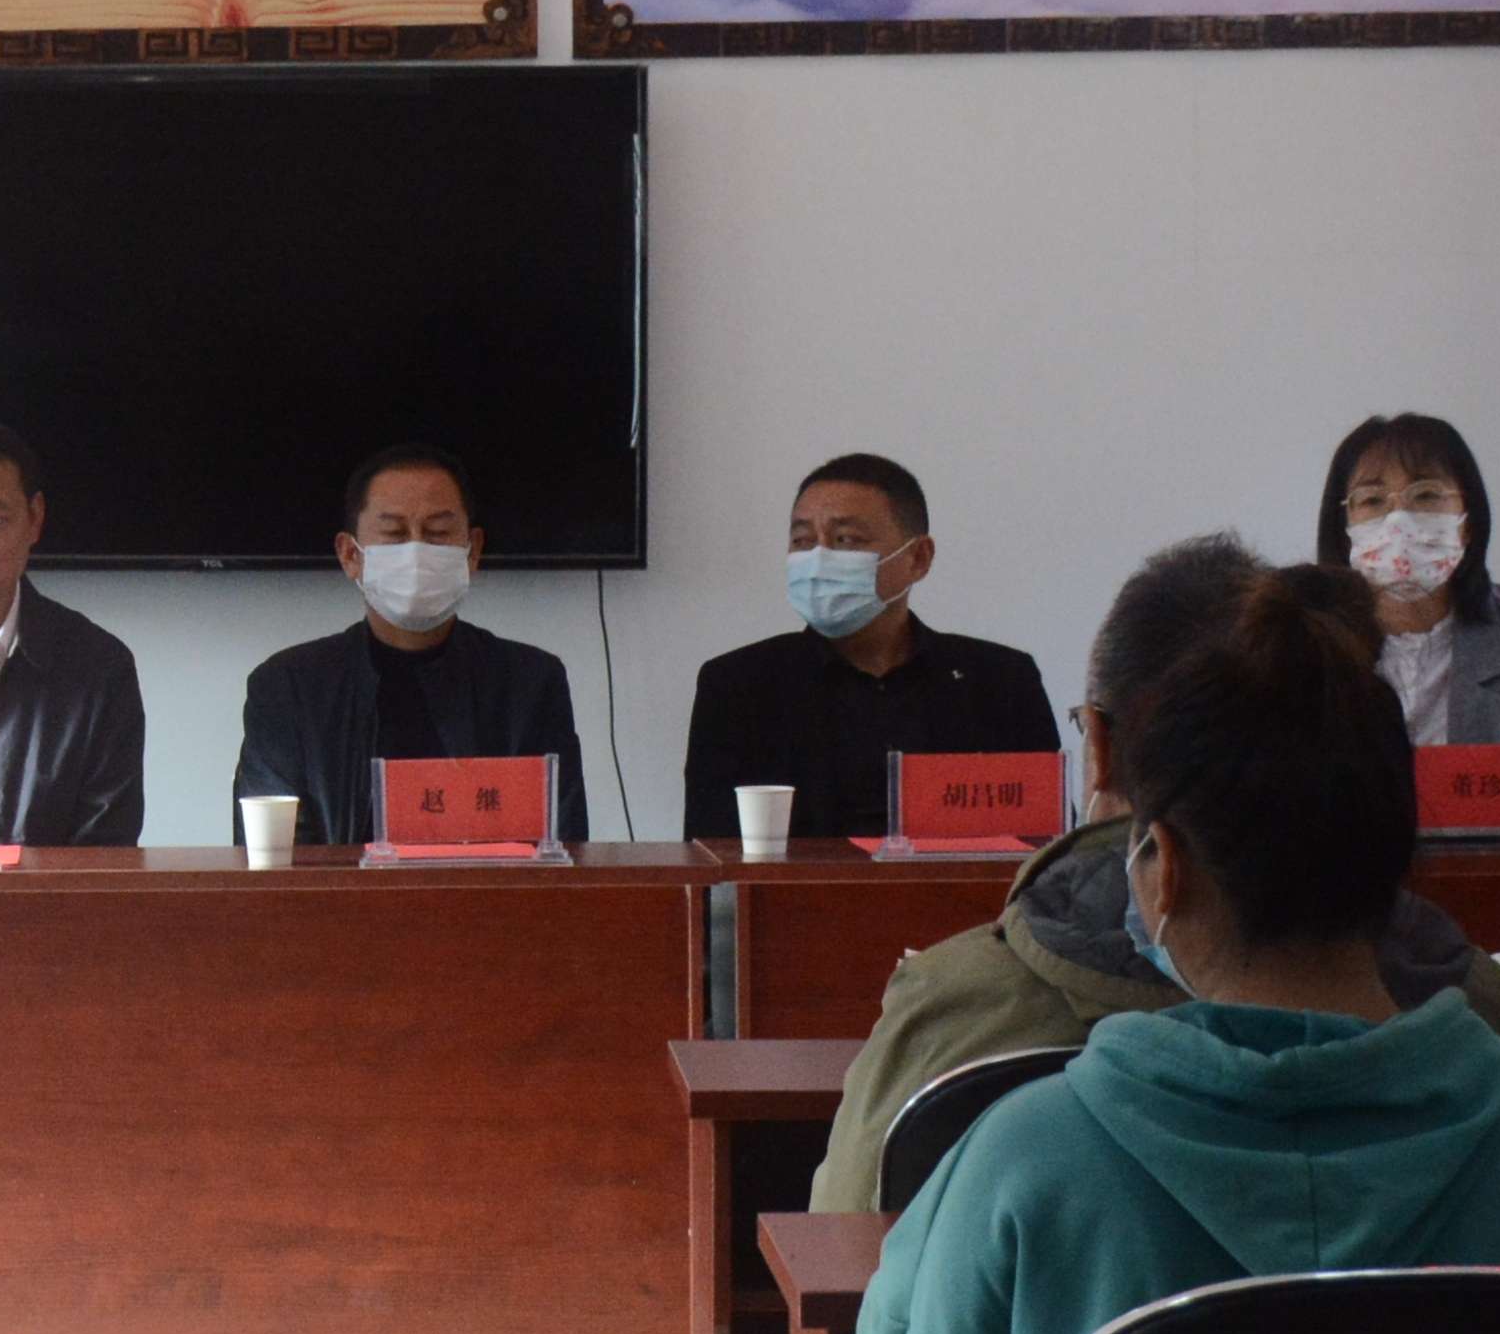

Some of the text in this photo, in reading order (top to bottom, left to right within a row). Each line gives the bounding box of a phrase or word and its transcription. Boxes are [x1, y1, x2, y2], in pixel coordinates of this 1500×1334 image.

[200, 558, 224, 568] TCL
[942, 782, 1024, 809] 胡昌明
